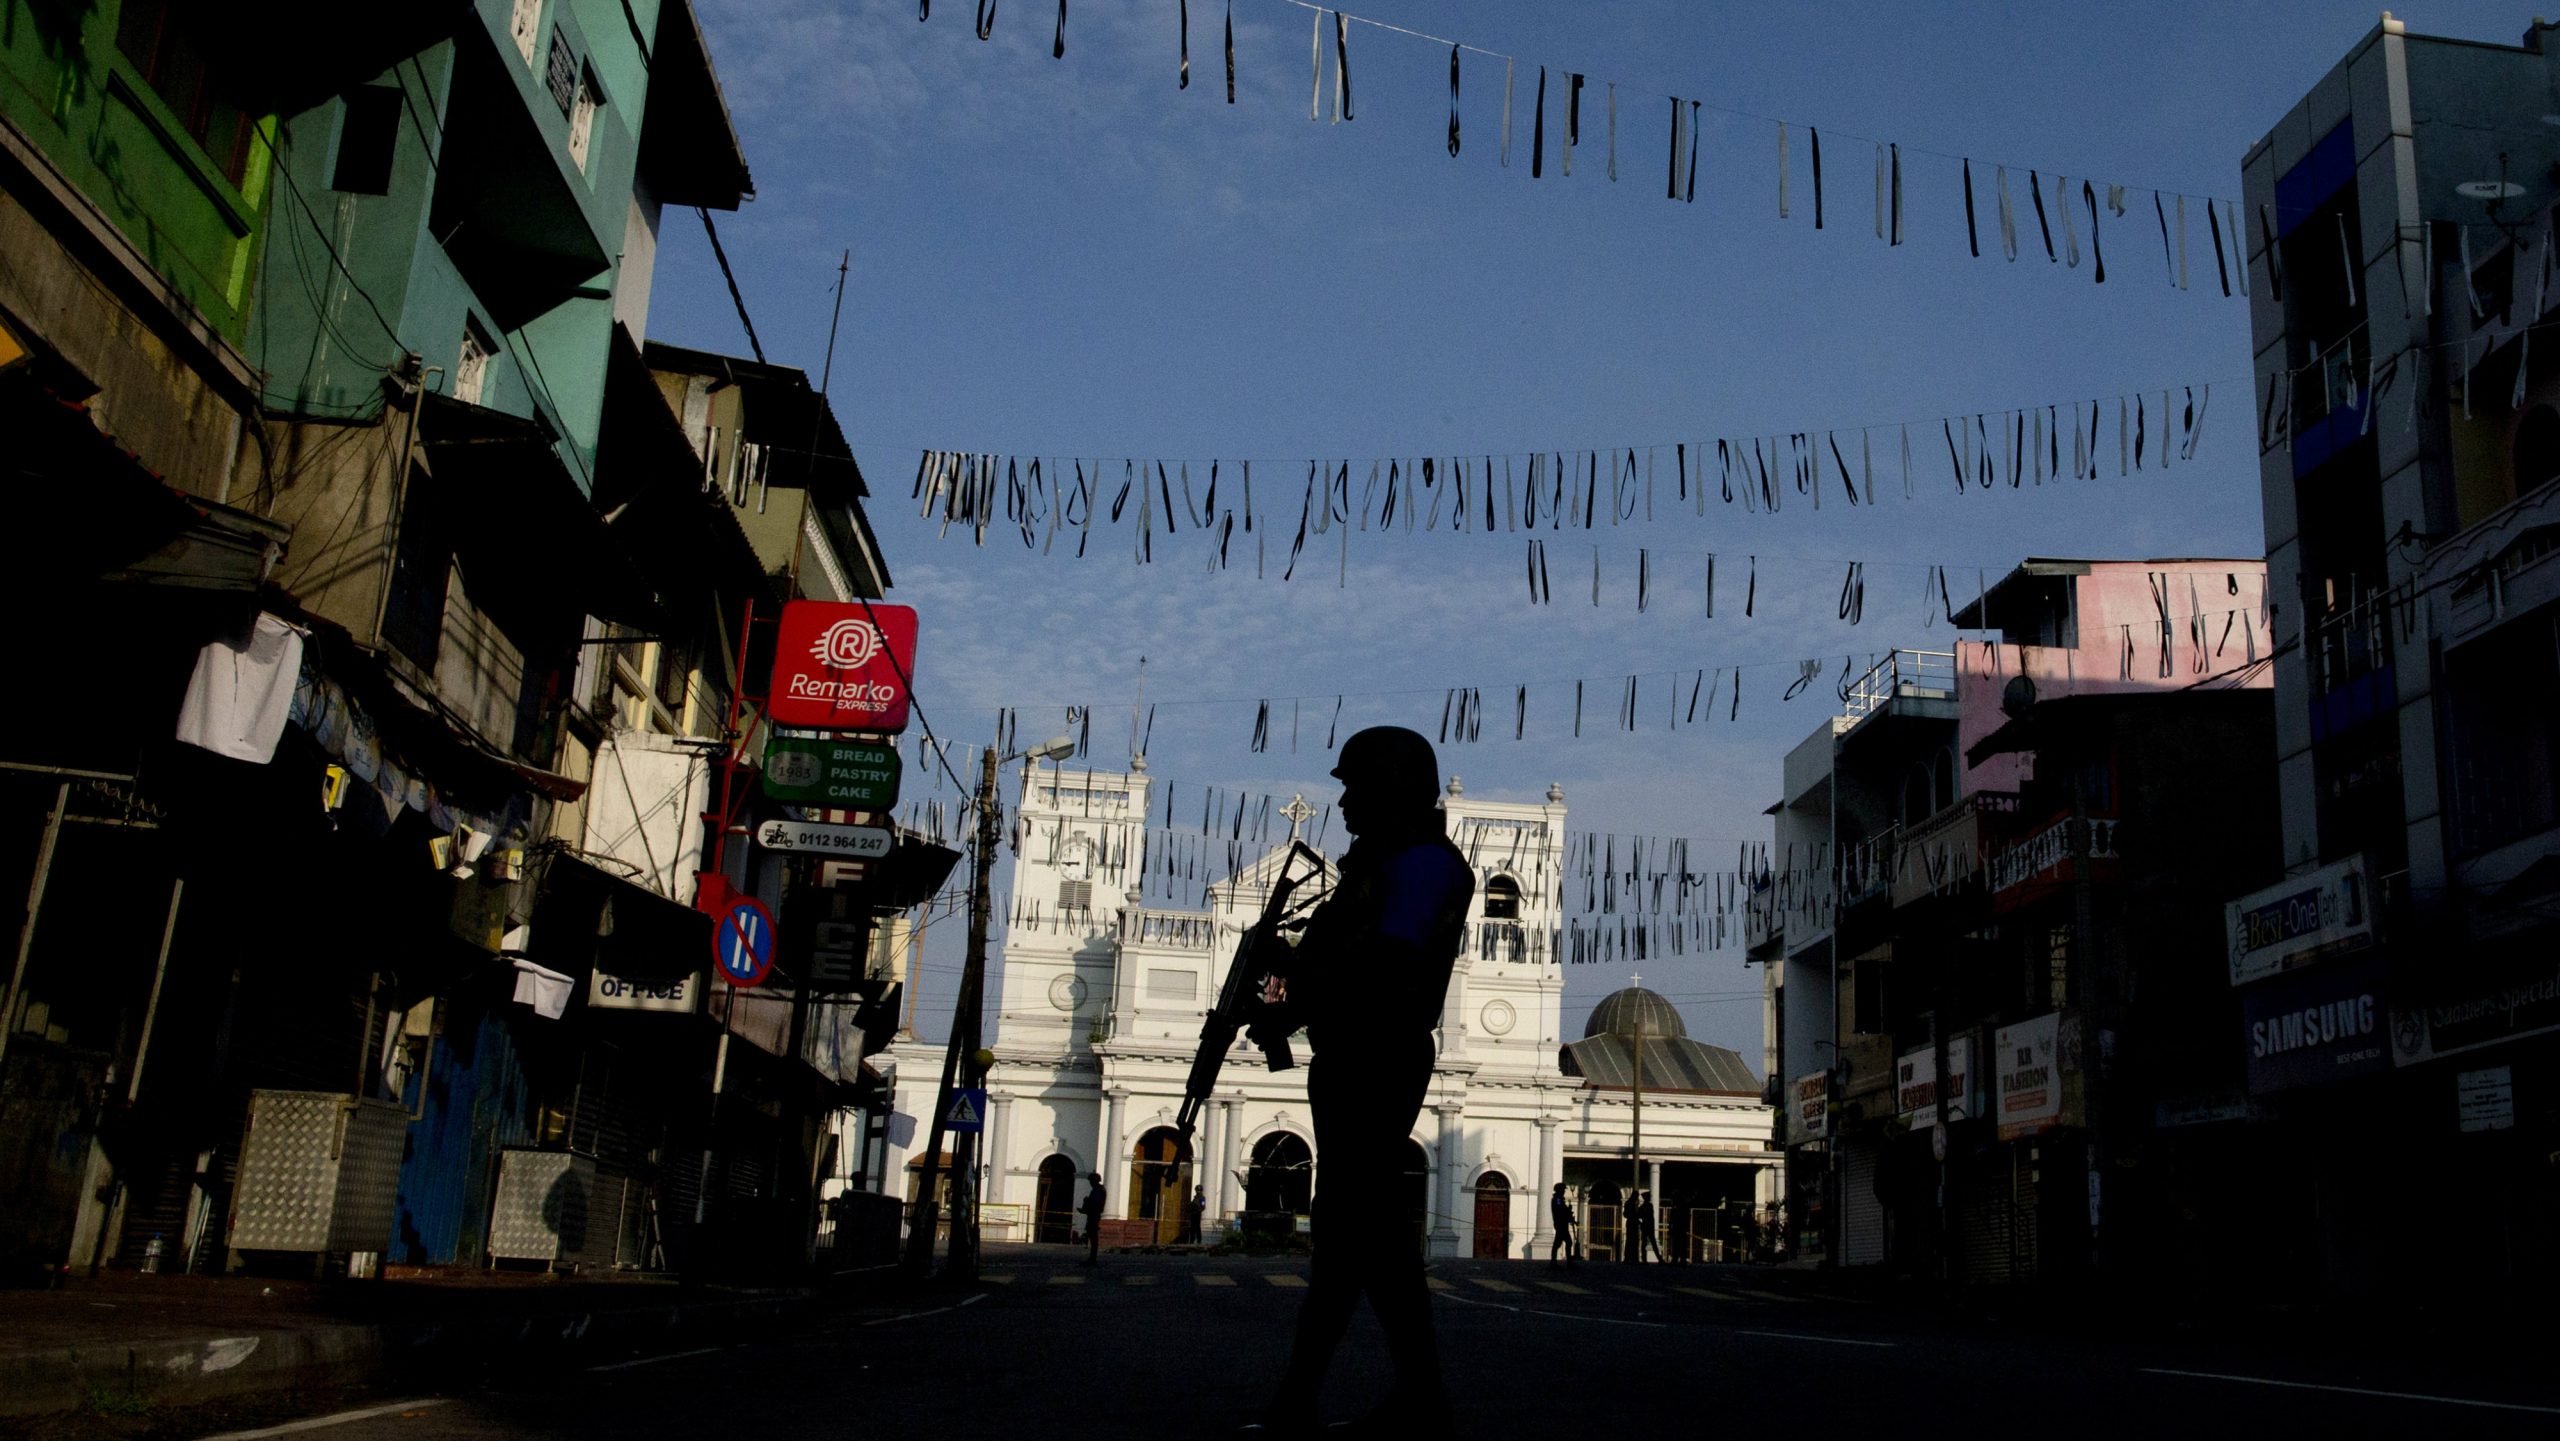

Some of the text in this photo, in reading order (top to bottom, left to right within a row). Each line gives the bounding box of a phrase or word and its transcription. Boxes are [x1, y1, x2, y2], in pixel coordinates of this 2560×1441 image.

[789, 674, 895, 701] Remarko
[836, 700, 888, 713] EXPRESS
[833, 749, 885, 763] BREAD
[778, 766, 812, 779] 1983
[830, 767, 890, 782] PASTRY
[828, 786, 872, 799] CAKE
[799, 833, 883, 850] 0112 964 247
[600, 979, 684, 1000] OFFICE
[2252, 993, 2375, 1059] SAMSUNG
[2003, 1066, 2049, 1093] FASHION
